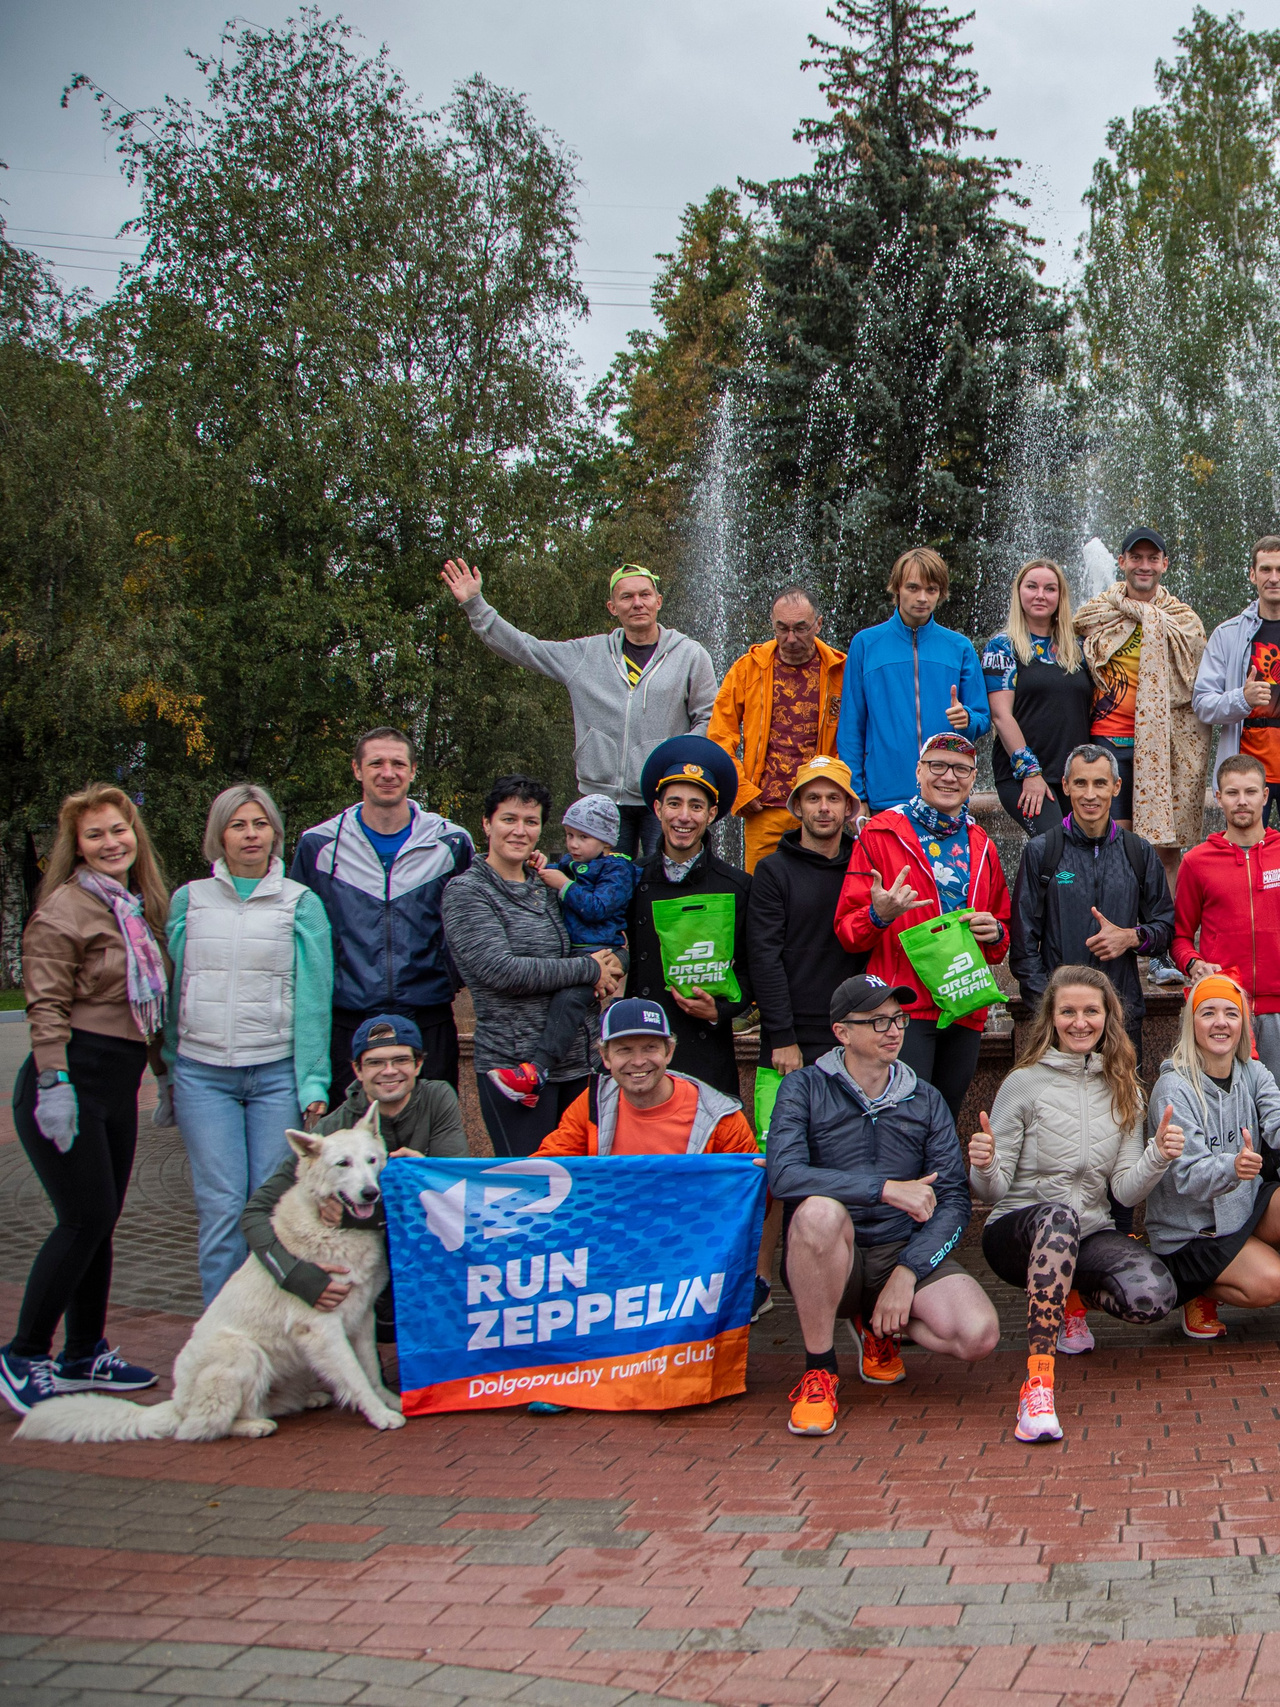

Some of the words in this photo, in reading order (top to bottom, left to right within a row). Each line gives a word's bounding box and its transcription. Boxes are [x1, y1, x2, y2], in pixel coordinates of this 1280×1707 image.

[668, 960, 730, 976] DREAM
[675, 971, 726, 986] TRAIL
[937, 965, 990, 996] DREAM
[947, 977, 992, 1002] TRAIL
[466, 1247, 589, 1306] RUN
[466, 1272, 726, 1352] ZEPPELIN
[468, 1366, 603, 1399] Dolgoprudny
[610, 1354, 668, 1380] running
[673, 1343, 716, 1367] club
